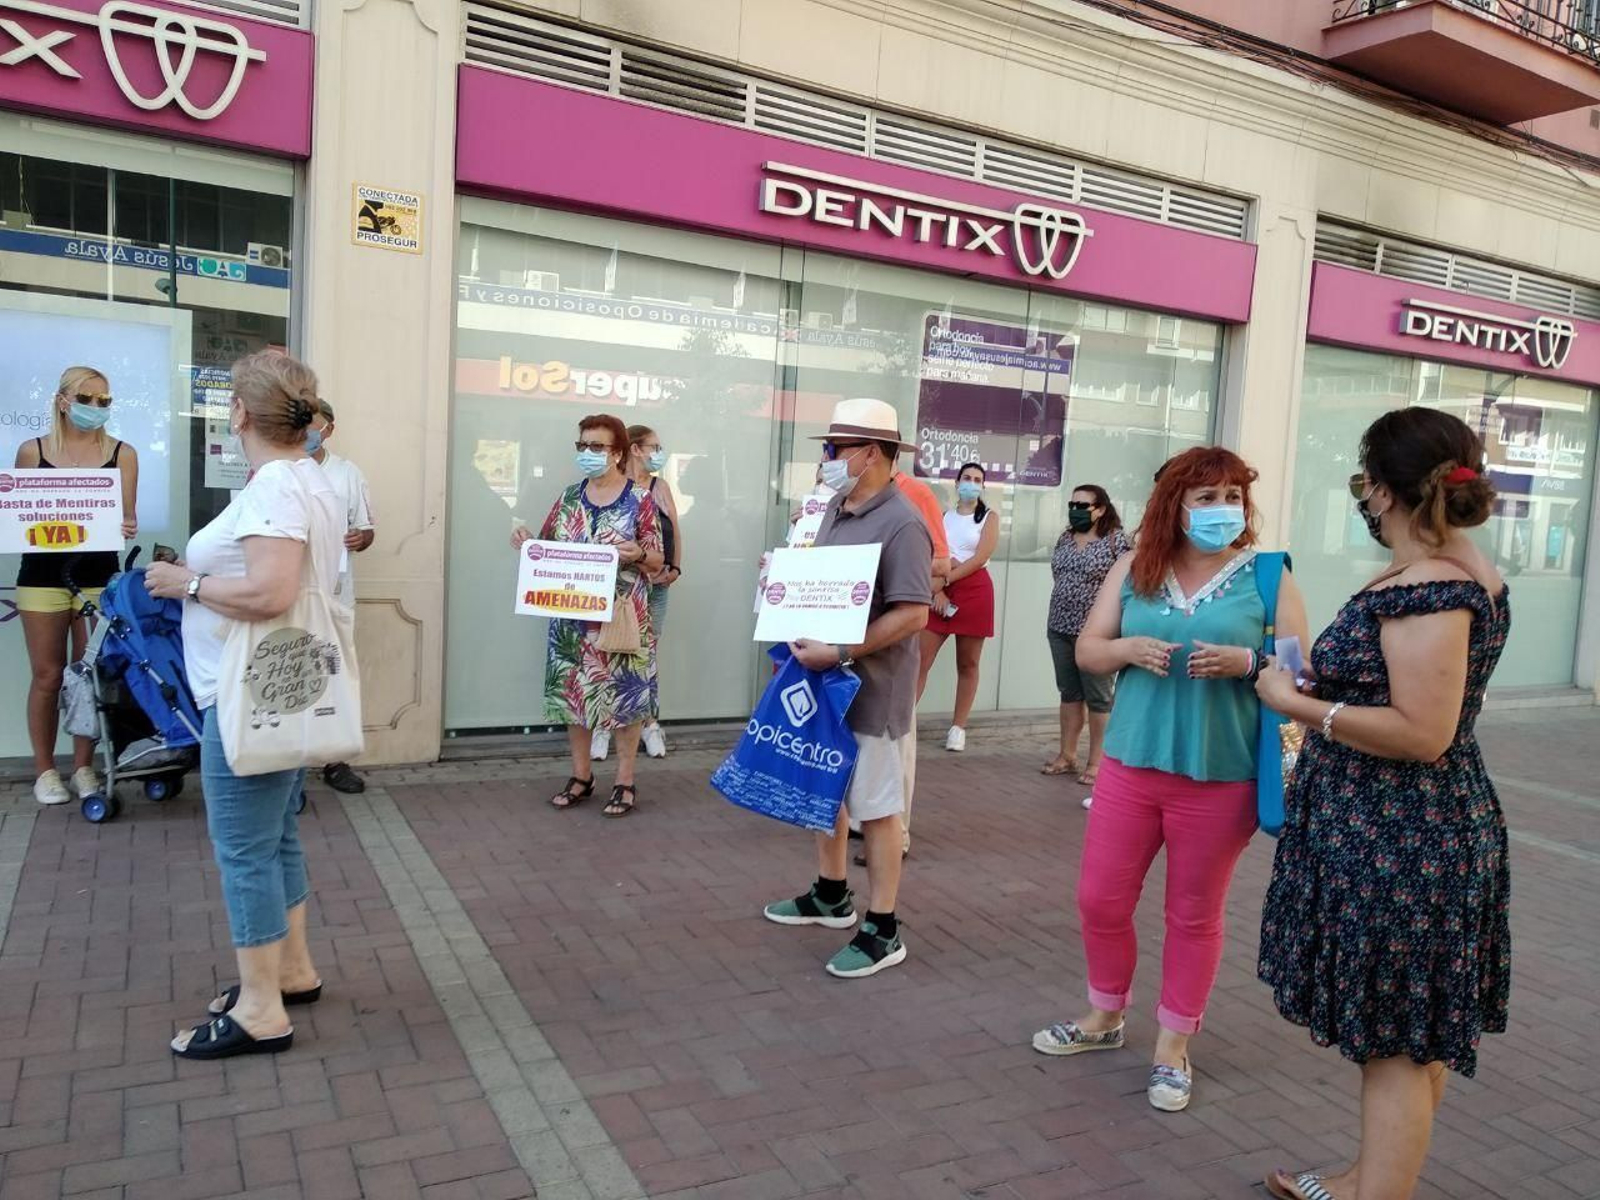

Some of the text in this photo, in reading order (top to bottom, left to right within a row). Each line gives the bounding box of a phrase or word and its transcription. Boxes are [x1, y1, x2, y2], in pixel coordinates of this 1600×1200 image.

[359, 187, 418, 205] CONECTADA
[760, 178, 1005, 256] DENTIX
[357, 231, 417, 249] PROSEGUR
[1403, 310, 1531, 355] DENTIX
[921, 427, 979, 443] Ortodoncia
[36, 498, 52, 509] de
[56, 498, 116, 509] Mentiras
[18, 511, 94, 522] soluciones
[533, 568, 605, 583] Estamos HARTOS
[564, 582, 576, 591] de
[524, 590, 607, 611] AMENAZAS
[254, 632, 317, 660] Seguro
[266, 659, 303, 679] Hoy
[261, 680, 305, 702] Gran
